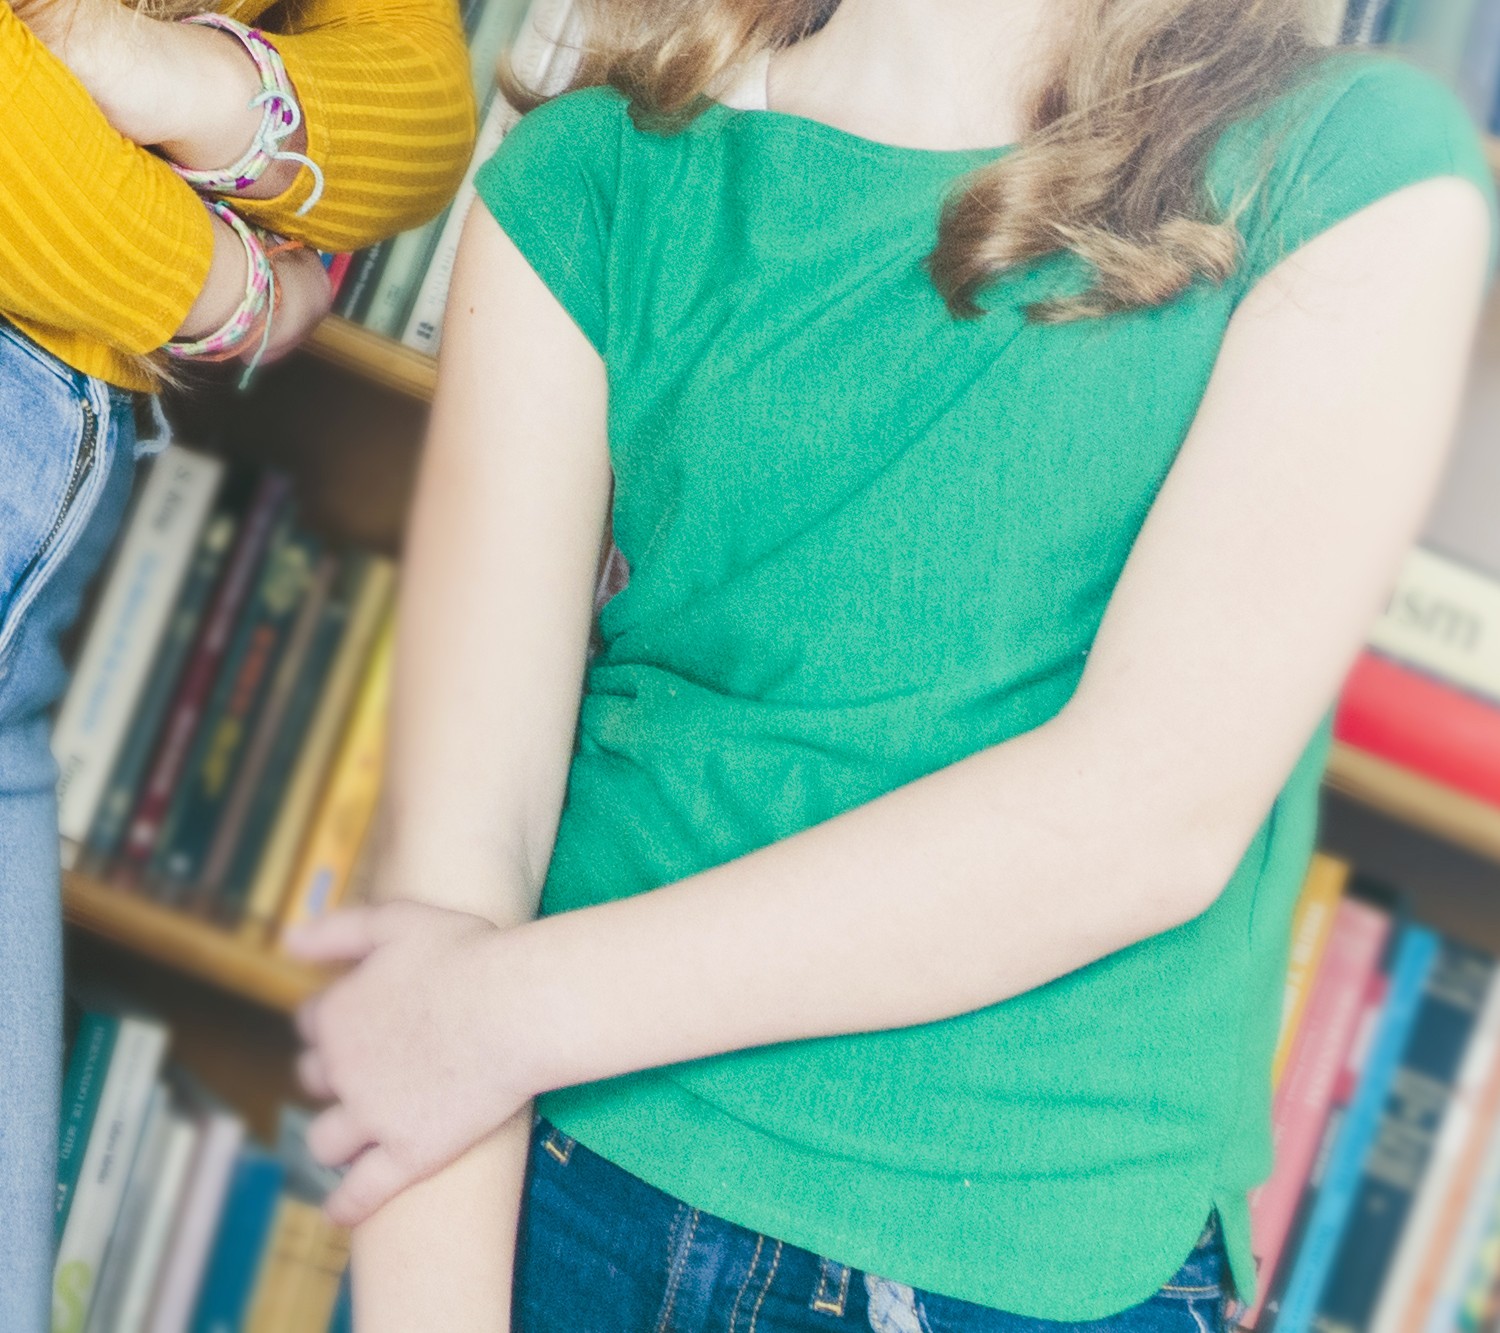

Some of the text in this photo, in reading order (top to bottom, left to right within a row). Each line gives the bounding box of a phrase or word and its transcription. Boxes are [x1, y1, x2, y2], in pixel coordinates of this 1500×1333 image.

[74, 1025, 106, 1102] HERNANDO
[1303, 984, 1358, 1109] MARXISM
[69, 1101, 85, 1121] DE
